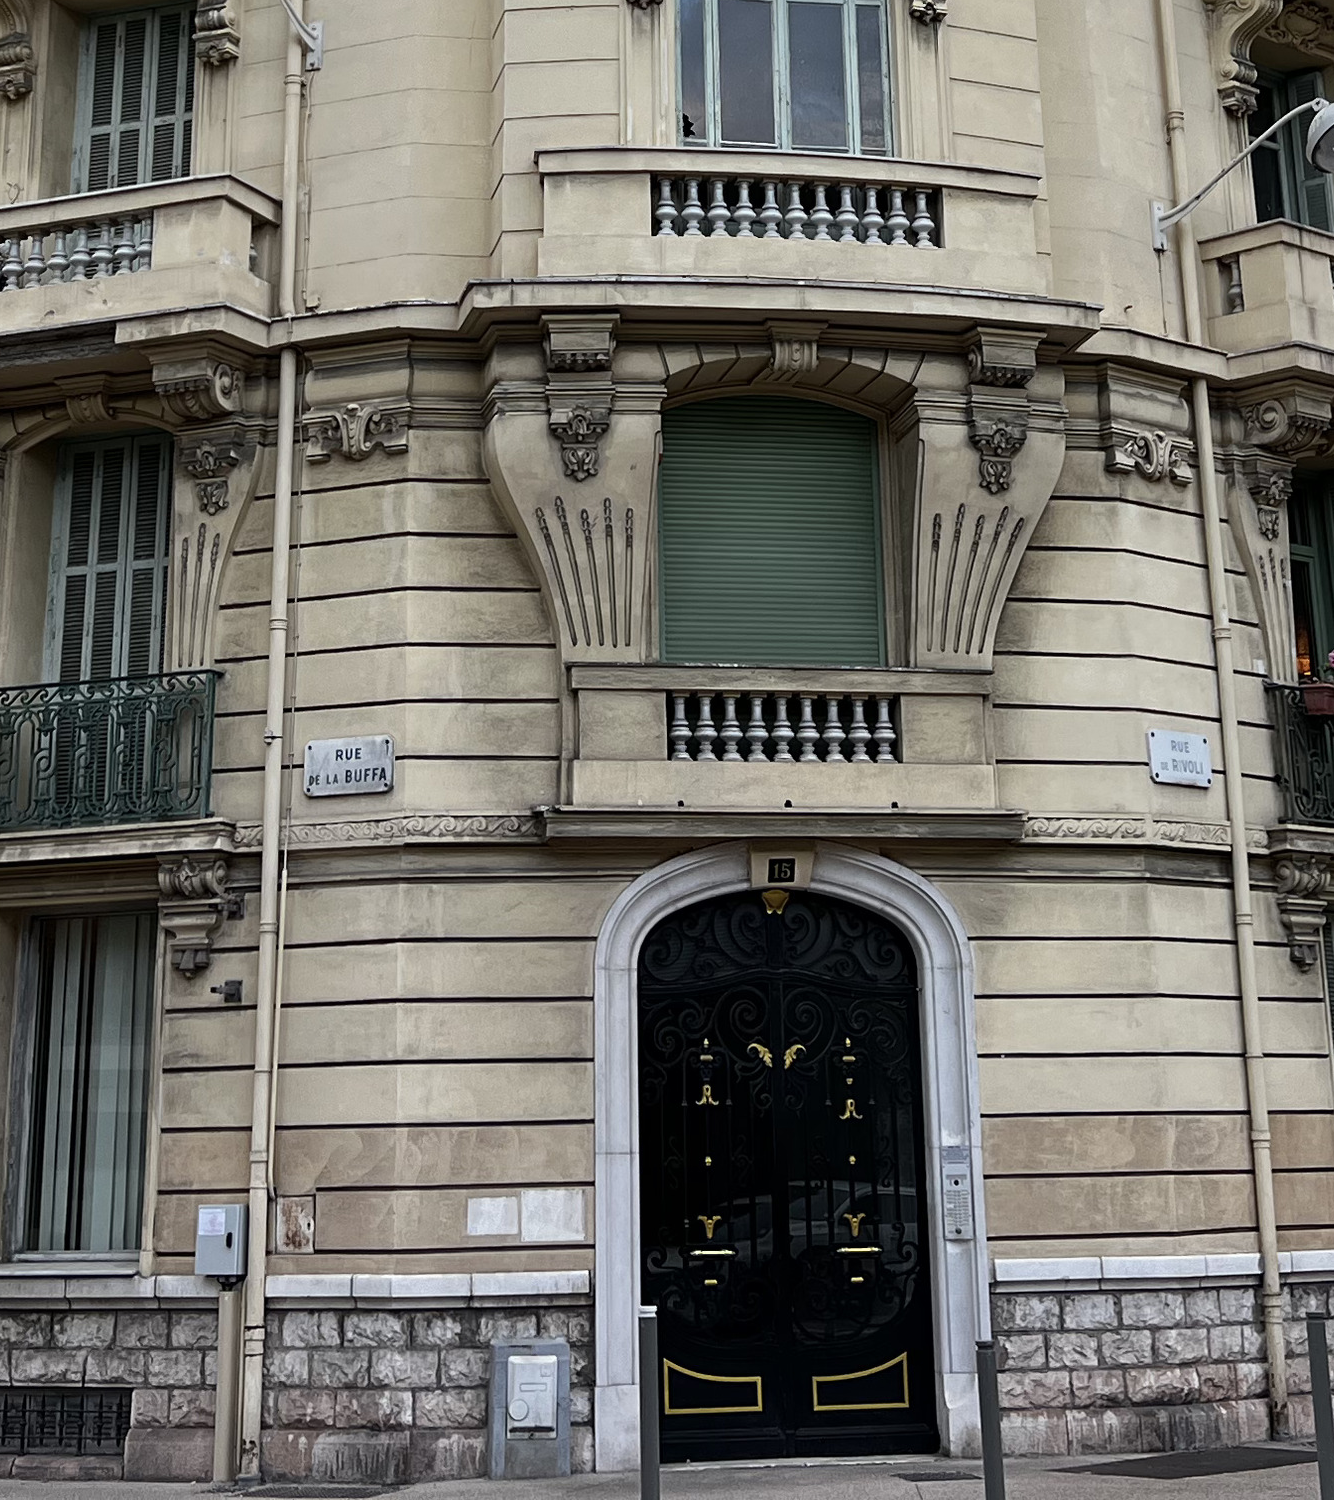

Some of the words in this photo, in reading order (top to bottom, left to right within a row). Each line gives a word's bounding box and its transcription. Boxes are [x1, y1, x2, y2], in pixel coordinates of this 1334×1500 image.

[335, 747, 362, 761] RUE
[1170, 740, 1190, 754] RUE
[1171, 758, 1204, 775] RIVOLI
[308, 774, 320, 786] DE
[326, 773, 339, 785] LA
[345, 767, 387, 783] BUFFA
[773, 862, 792, 879] 15
